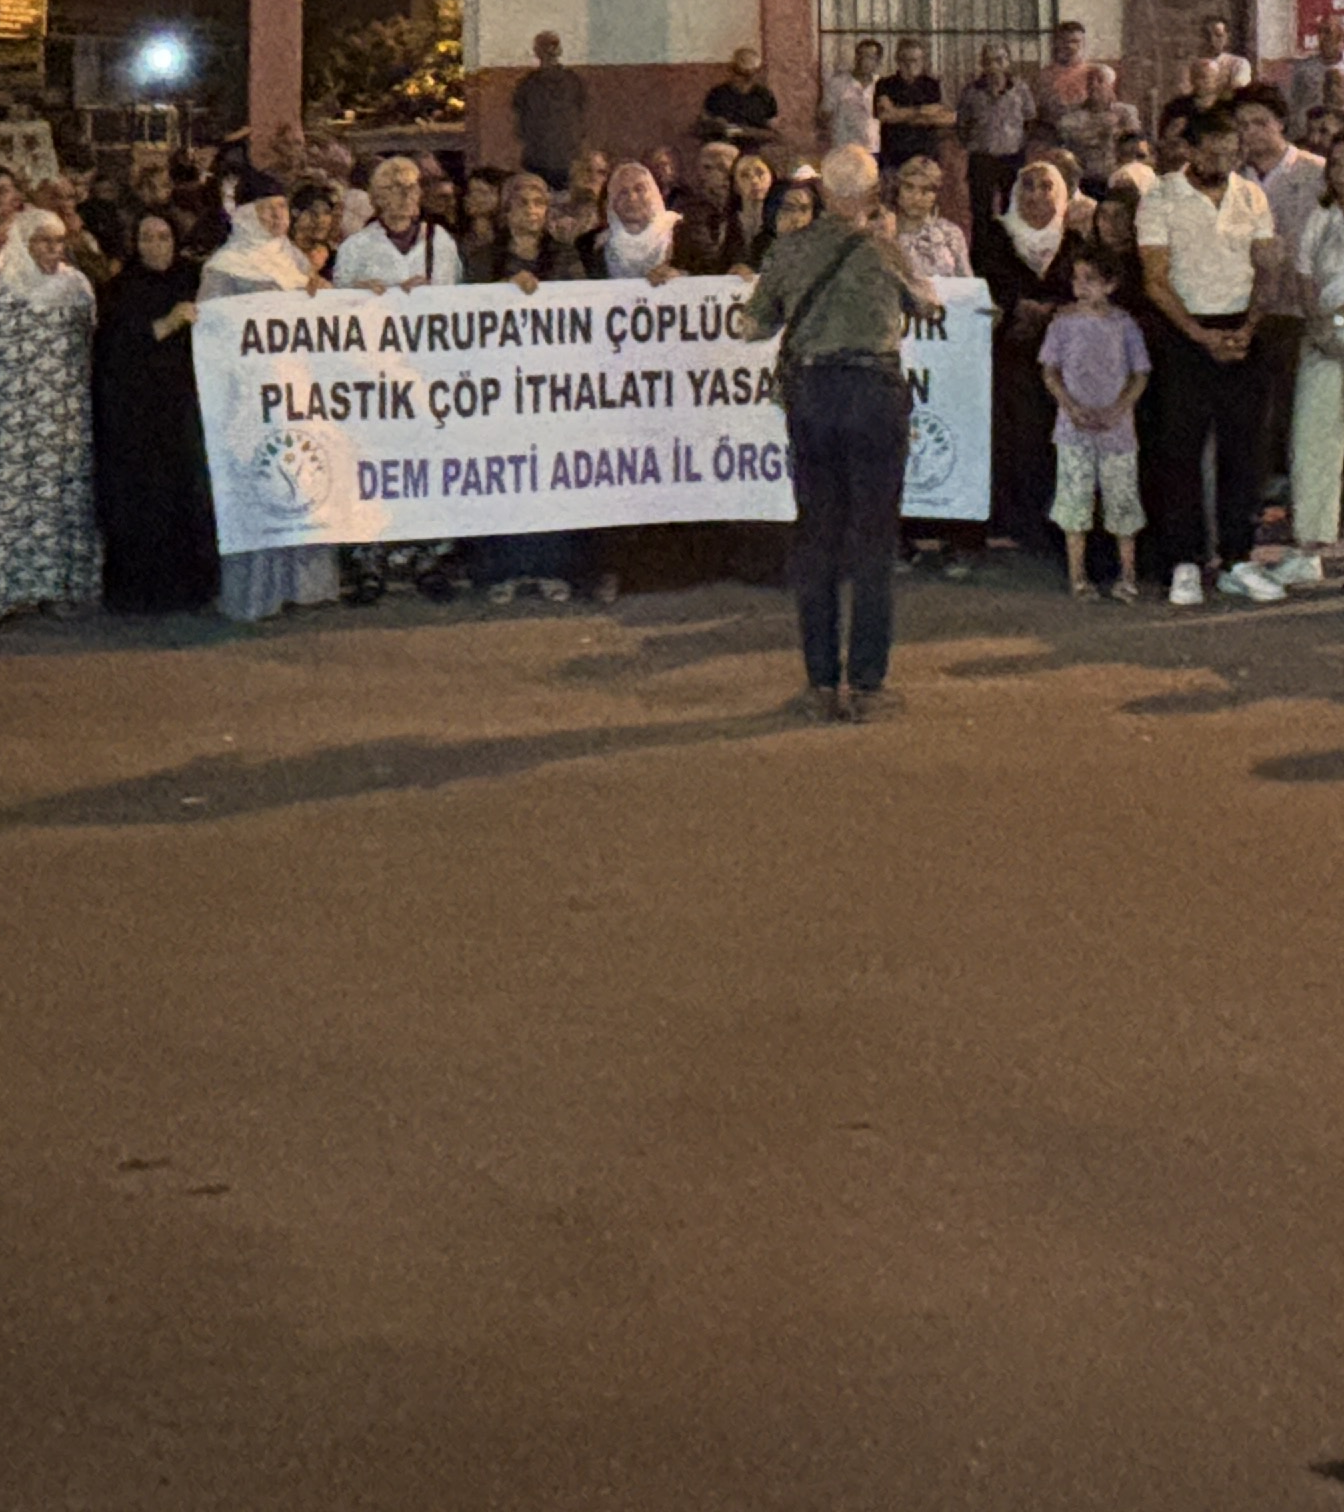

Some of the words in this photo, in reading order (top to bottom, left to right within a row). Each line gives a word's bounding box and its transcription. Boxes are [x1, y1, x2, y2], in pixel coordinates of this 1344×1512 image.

[241, 315, 367, 355] ADANA
[378, 306, 592, 353] AVRUPA'NIN
[607, 294, 749, 353] ÇÖPLÜĞ
[261, 371, 415, 423] PLASTİK
[428, 370, 500, 429] ÇÖP
[514, 365, 674, 414] İTHALATI
[358, 458, 429, 501] DEM
[442, 443, 538, 497] PARTİ
[551, 445, 661, 489] ADANA
[673, 437, 702, 484] İL
